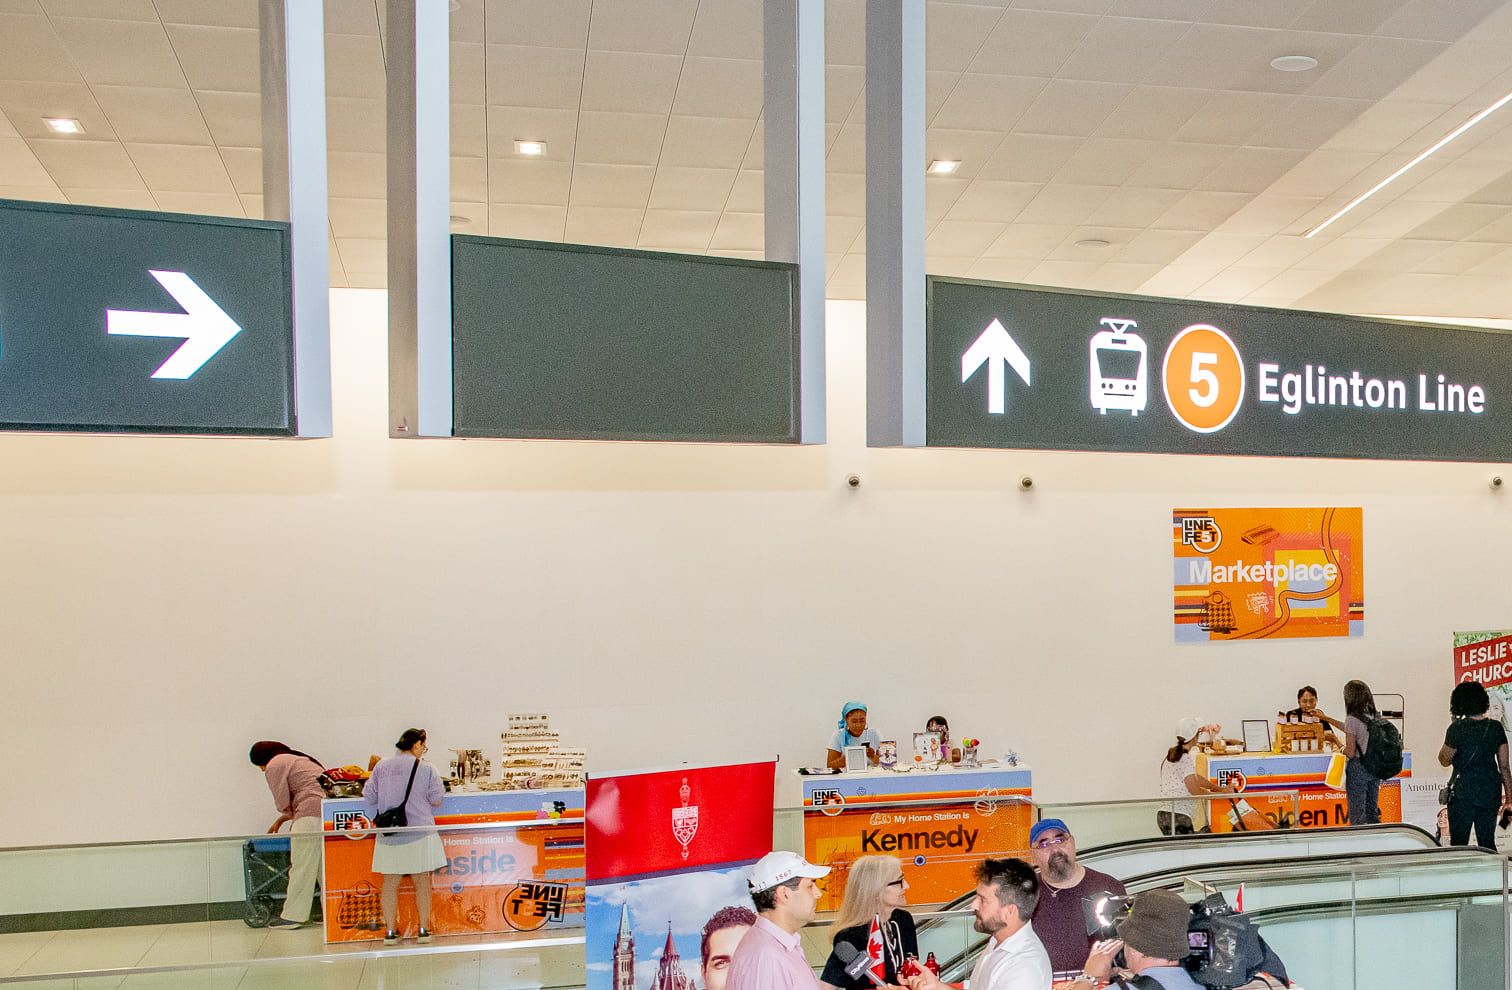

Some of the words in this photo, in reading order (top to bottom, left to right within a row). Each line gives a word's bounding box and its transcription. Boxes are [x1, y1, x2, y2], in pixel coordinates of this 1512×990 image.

[1187, 351, 1220, 409] 5
[1258, 362, 1406, 416] Eglinton
[1418, 373, 1486, 414] Line
[1189, 559, 1337, 588] Marketplace
[1461, 642, 1507, 667] LESLIE
[1302, 793, 1324, 801] Home
[894, 815, 907, 825] My
[908, 813, 932, 823] Home
[934, 812, 961, 821] Station
[443, 838, 471, 846] Home
[472, 836, 504, 845] Station
[861, 824, 978, 853] Kennedy
